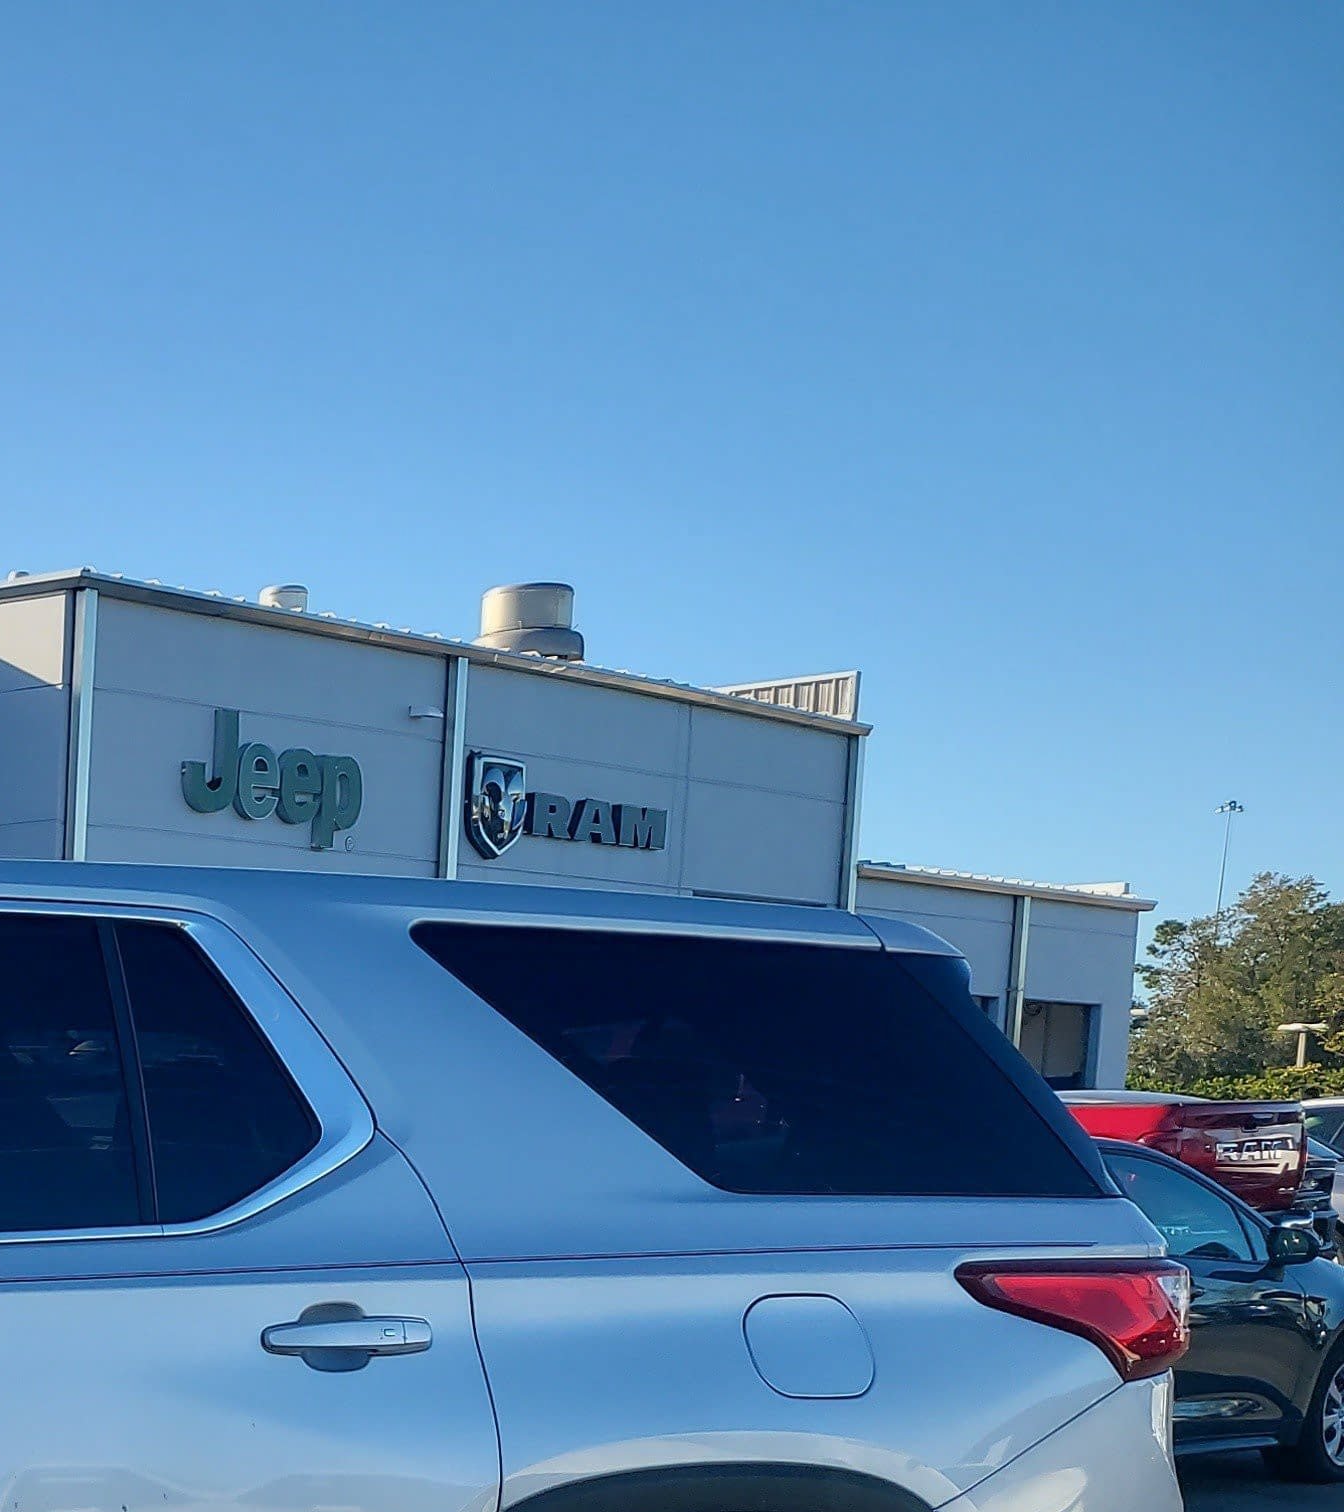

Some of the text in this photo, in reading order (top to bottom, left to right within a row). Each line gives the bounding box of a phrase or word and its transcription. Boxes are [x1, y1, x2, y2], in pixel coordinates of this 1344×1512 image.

[181, 708, 363, 850] Jeep
[524, 792, 668, 850] RAM
[1216, 1141, 1283, 1161] RAM
